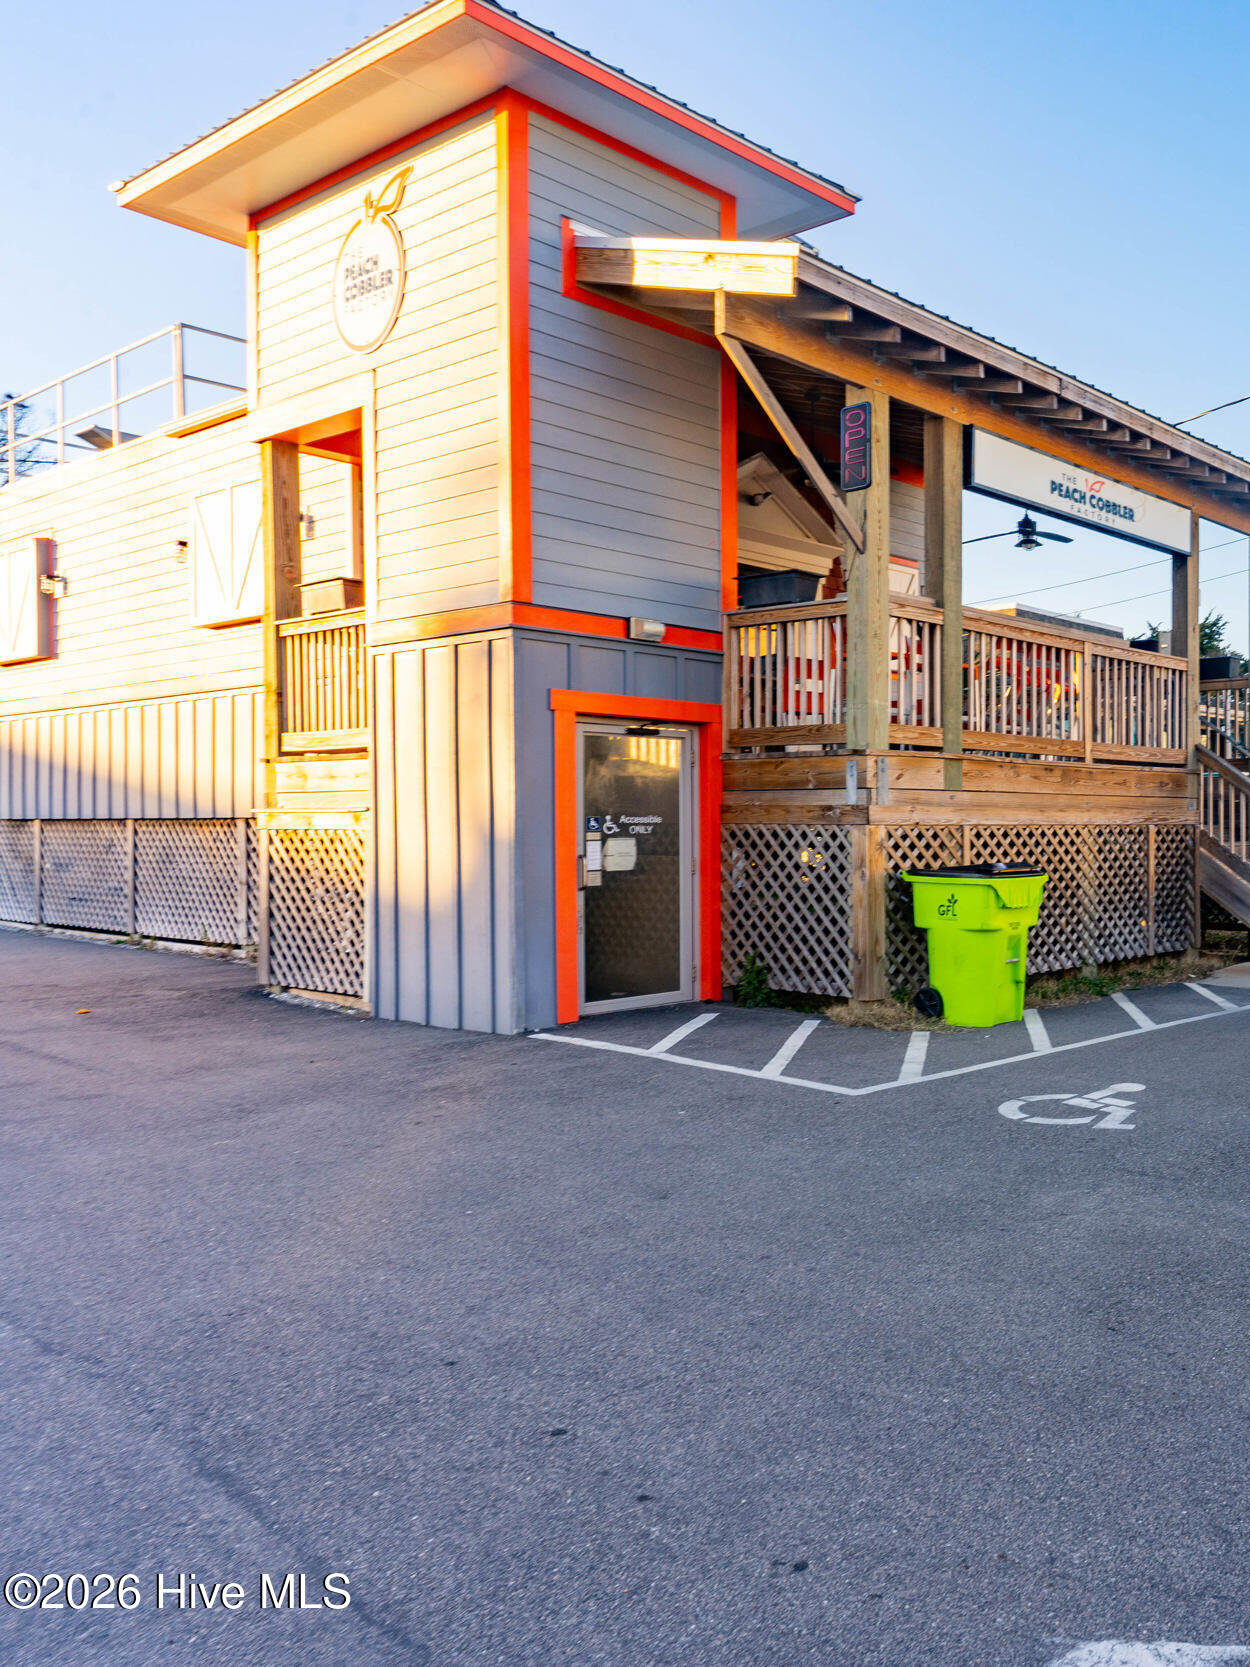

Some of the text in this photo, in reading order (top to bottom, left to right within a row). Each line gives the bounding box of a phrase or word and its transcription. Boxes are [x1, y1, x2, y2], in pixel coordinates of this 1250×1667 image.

[845, 409, 867, 483] OPEN
[1062, 473, 1077, 485] THE
[1050, 480, 1135, 522] PEACH COBBLER
[1070, 504, 1116, 525] FACTORY
[619, 815, 663, 824] Accessible
[628, 825, 654, 834] ONLY
[937, 903, 958, 917] GFL
